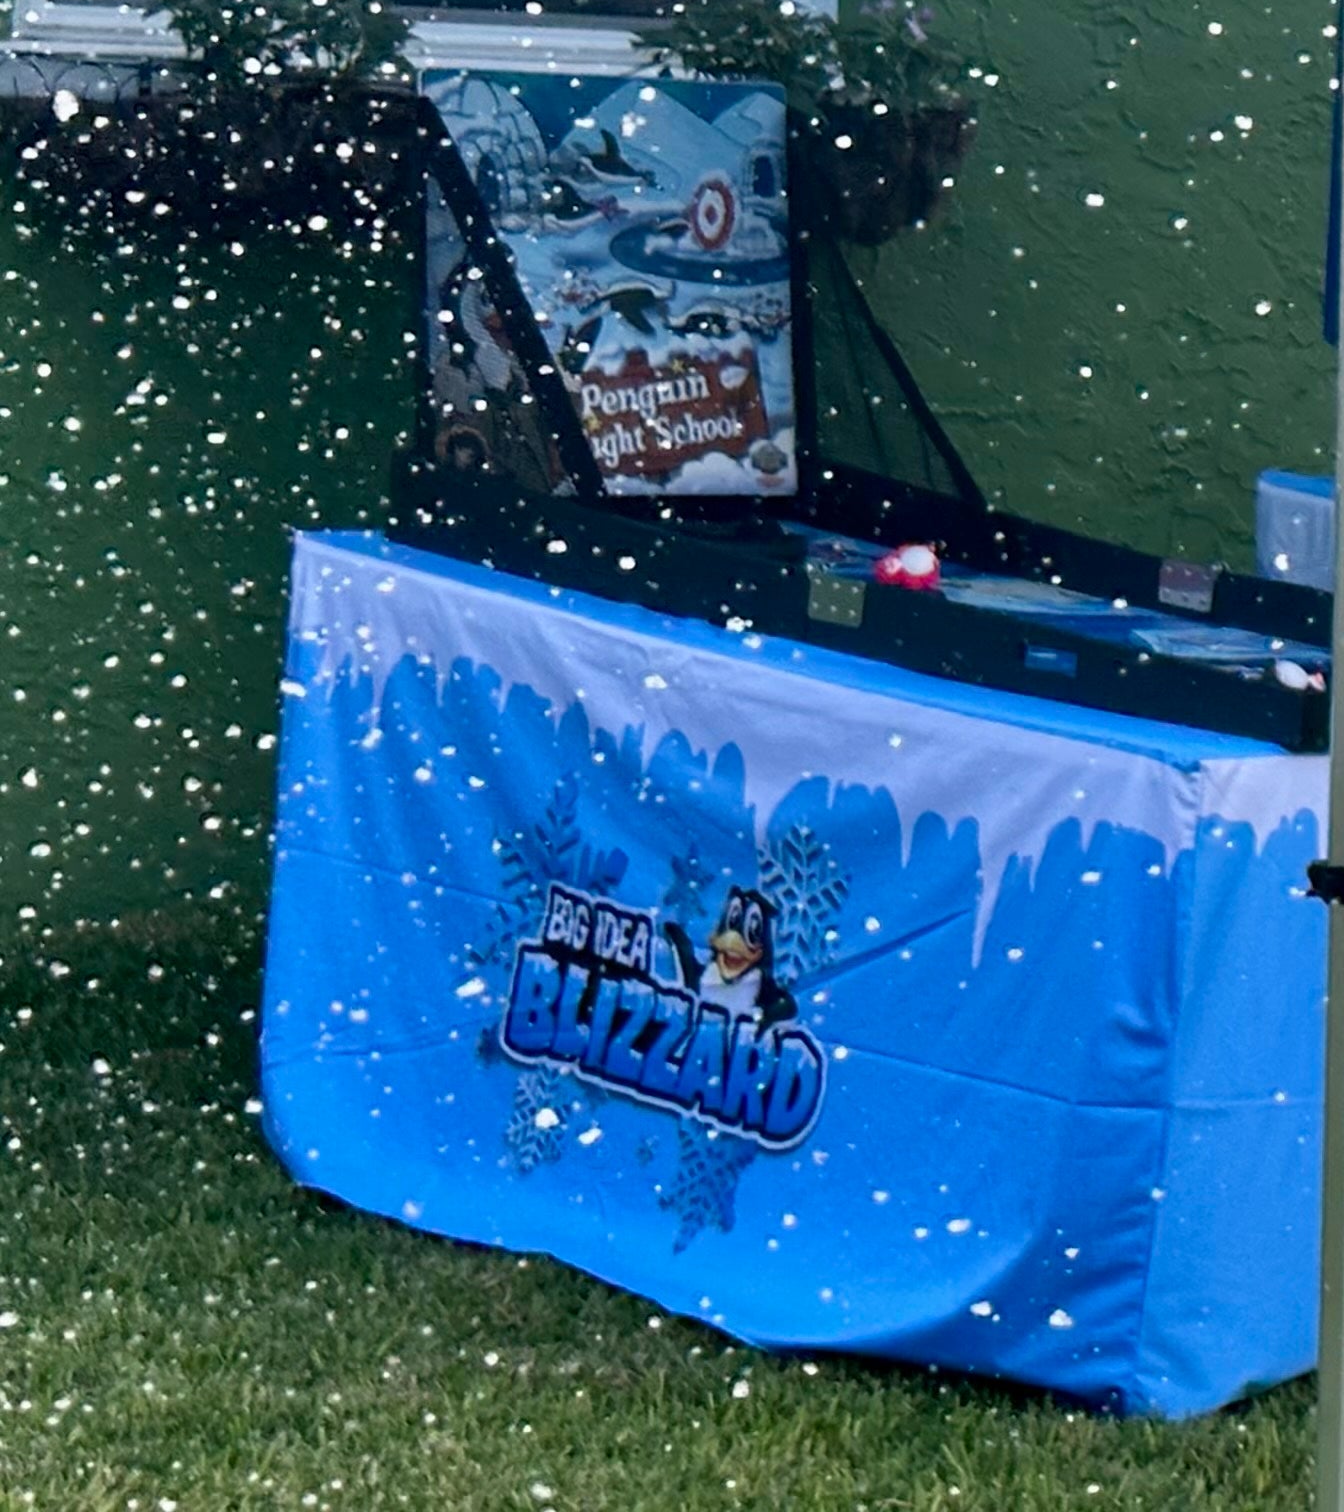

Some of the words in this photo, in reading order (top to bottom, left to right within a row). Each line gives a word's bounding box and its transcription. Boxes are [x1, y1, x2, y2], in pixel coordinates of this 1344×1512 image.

[581, 373, 711, 419] Penguin
[655, 410, 744, 450] School
[547, 893, 591, 951] BIG
[594, 909, 650, 971] IDEA
[509, 948, 824, 1138] BLIZZARD
